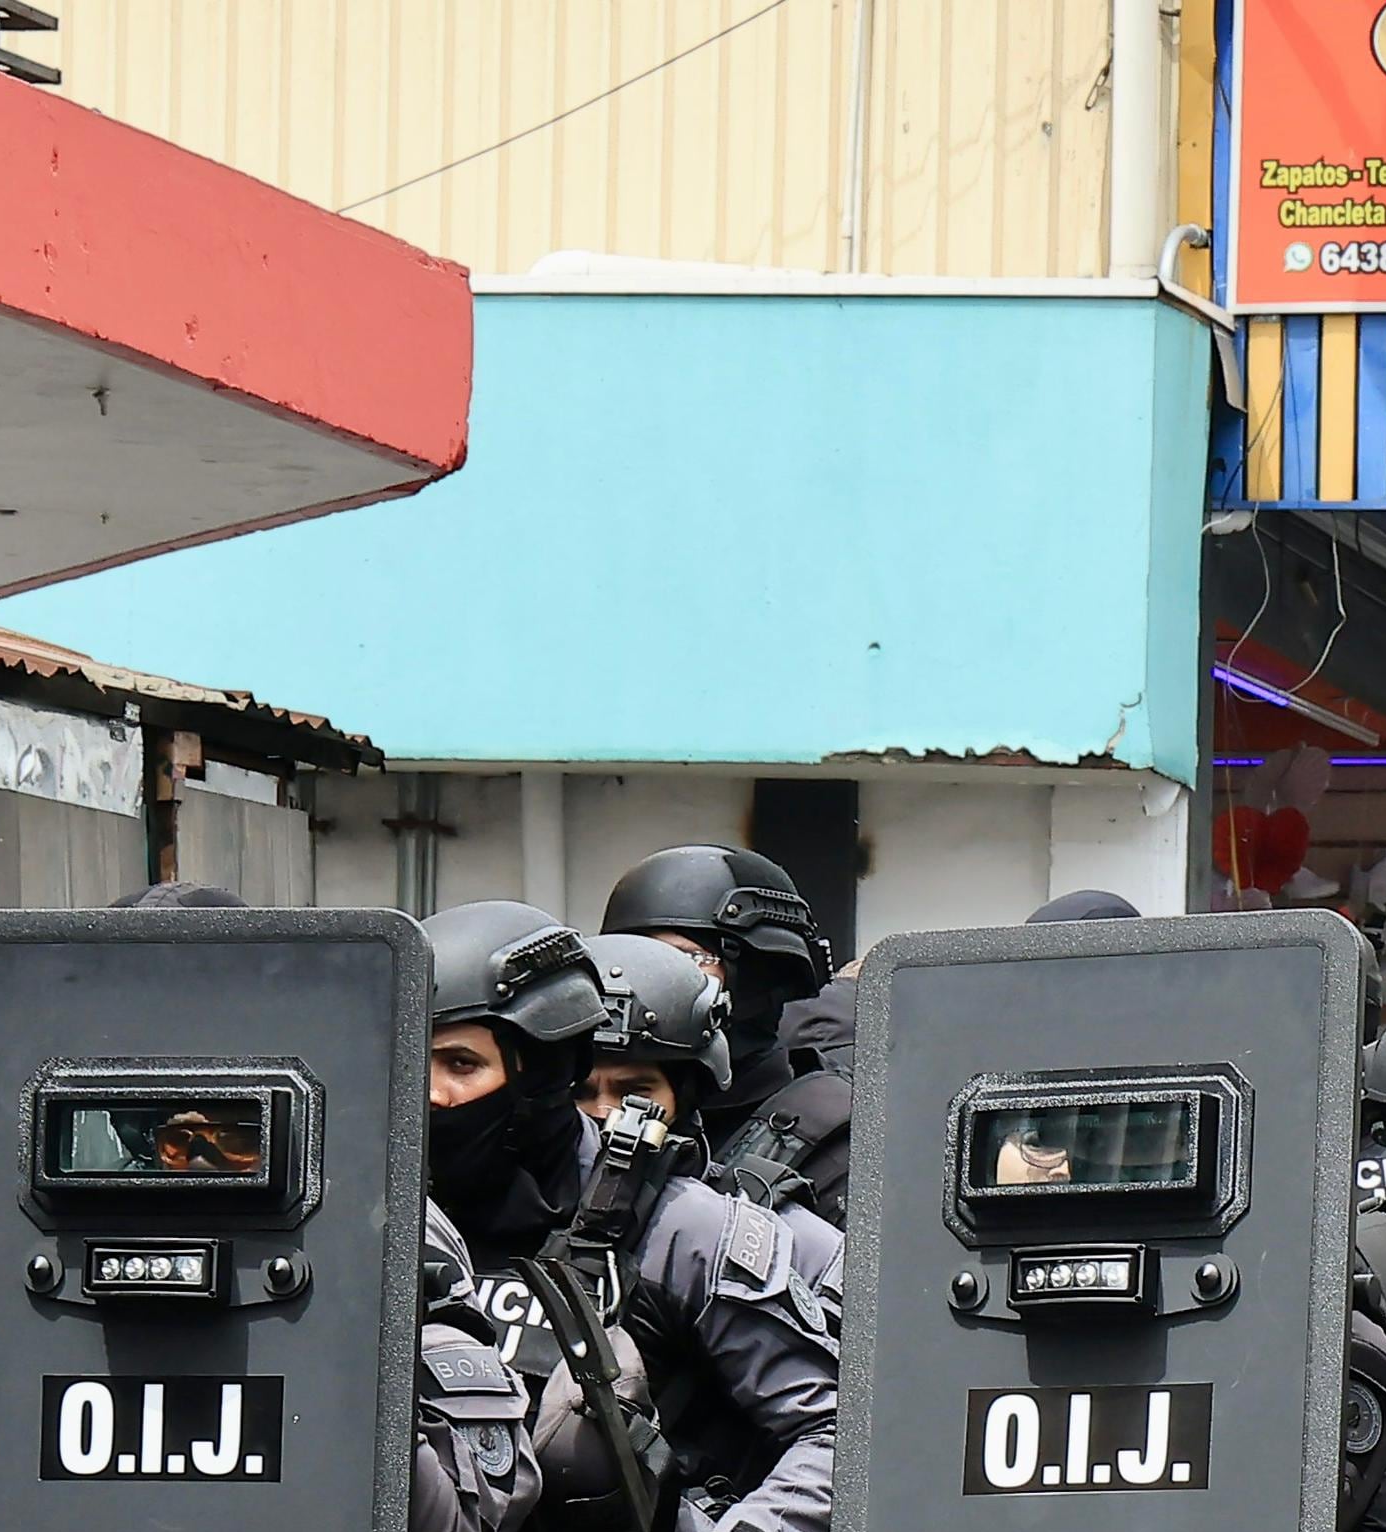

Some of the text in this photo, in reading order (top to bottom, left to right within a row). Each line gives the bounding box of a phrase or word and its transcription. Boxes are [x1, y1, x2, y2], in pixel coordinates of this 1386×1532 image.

[1261, 157, 1349, 193] Zapatos
[59, 1381, 263, 1475] O.I.J.
[984, 1390, 1191, 1488] O.I.J.
